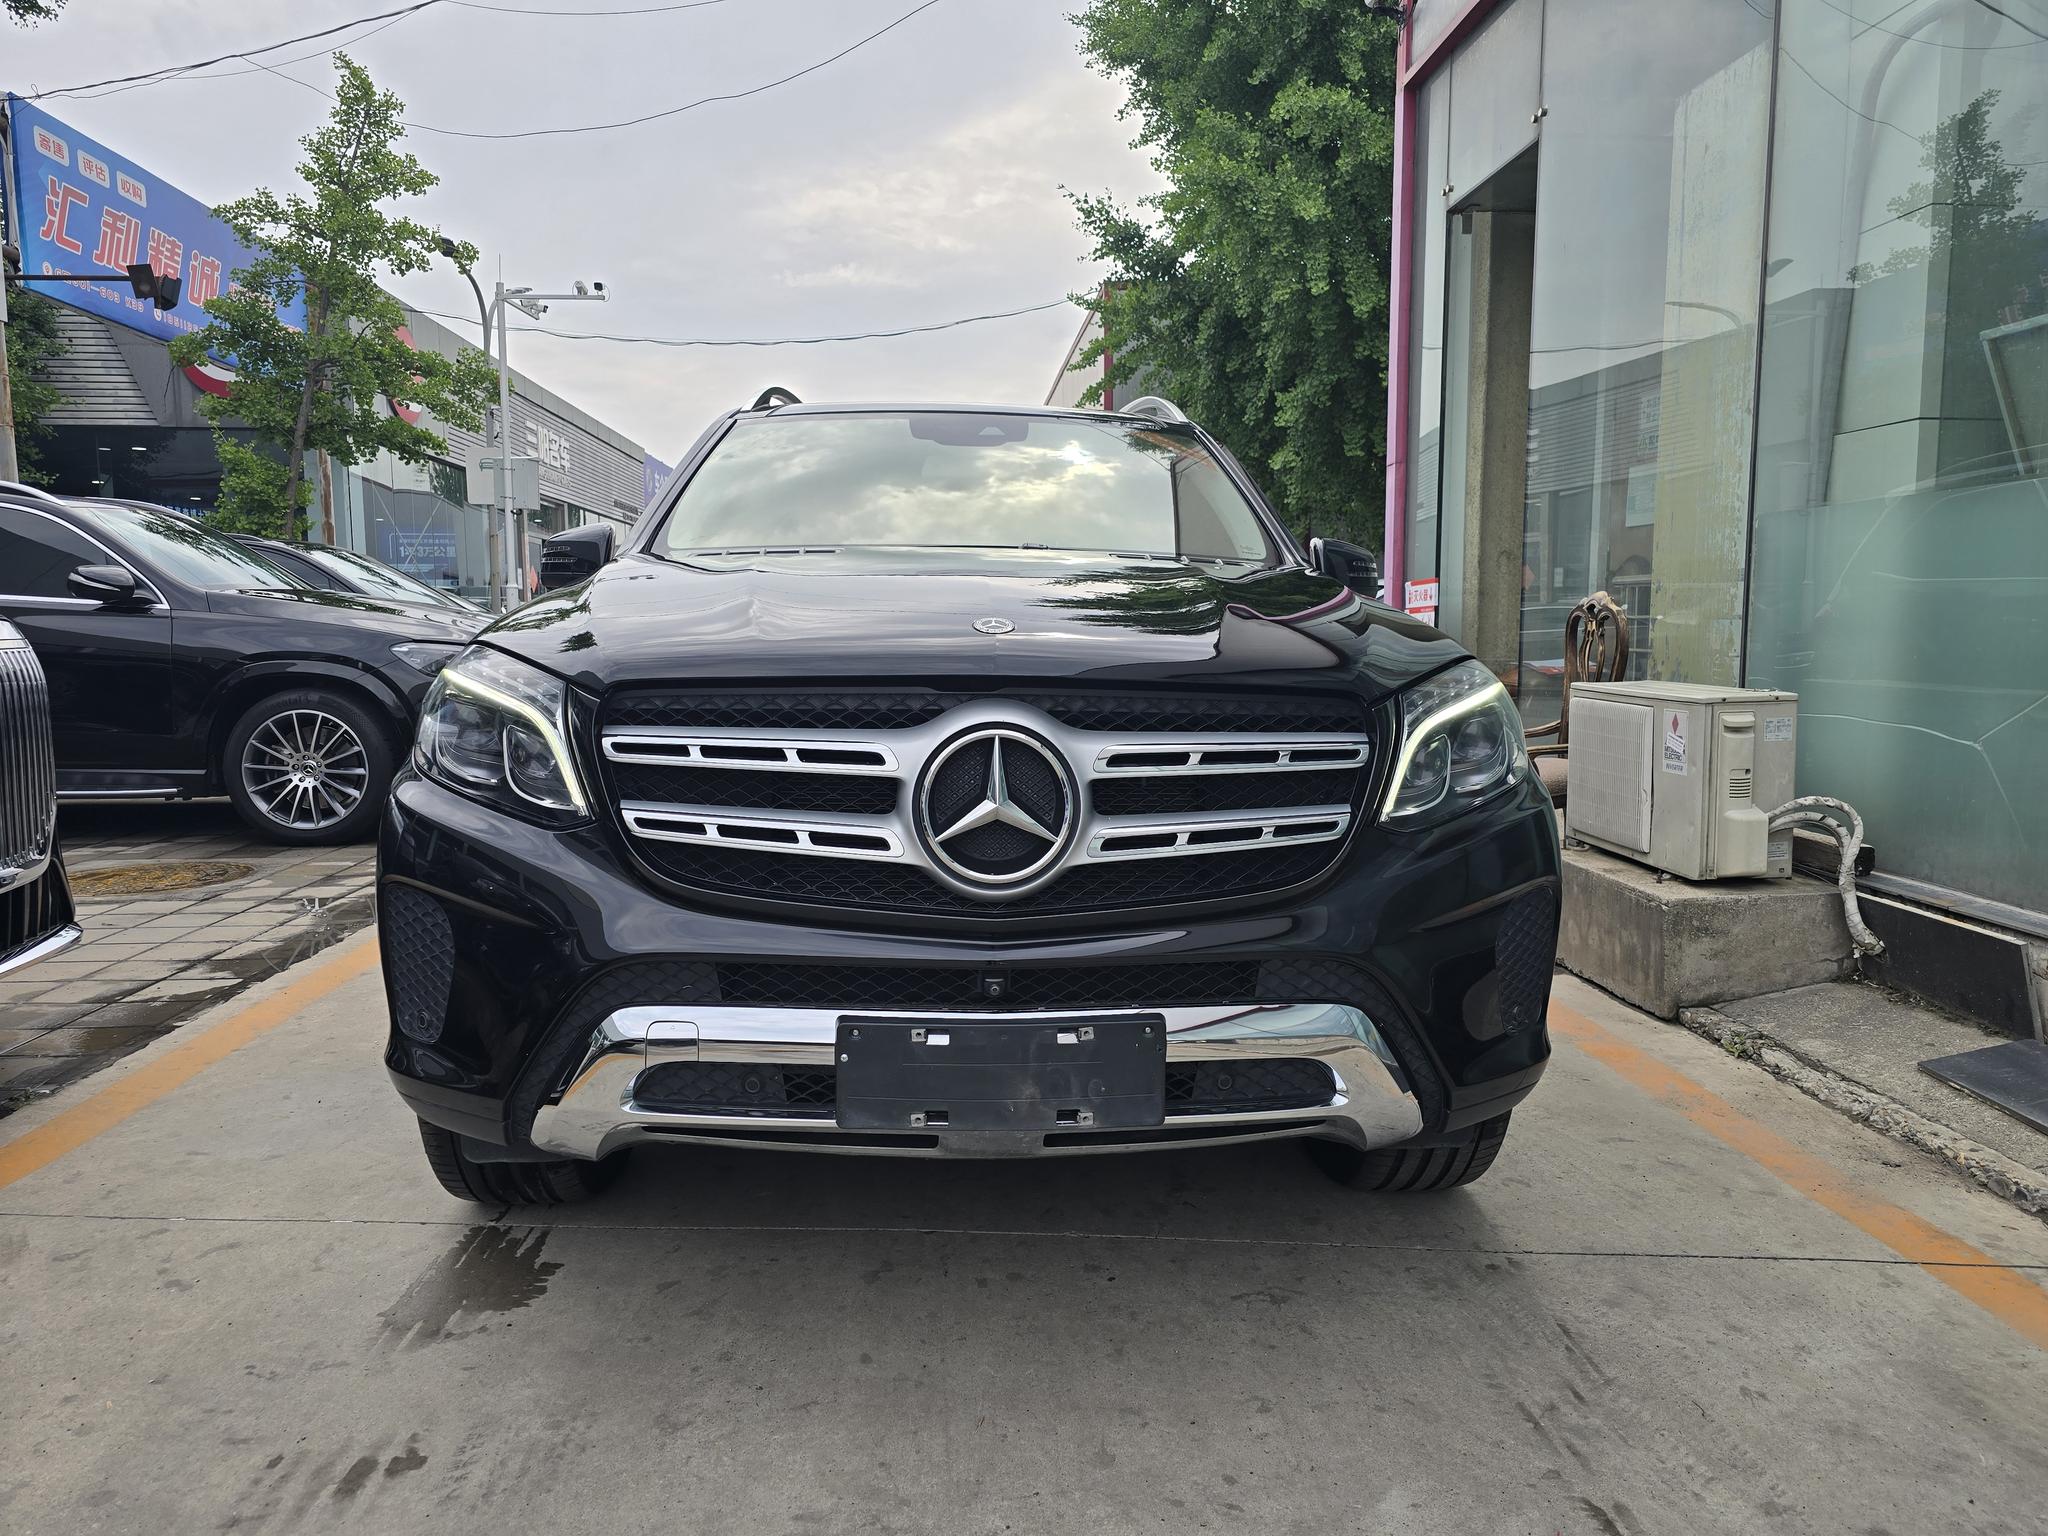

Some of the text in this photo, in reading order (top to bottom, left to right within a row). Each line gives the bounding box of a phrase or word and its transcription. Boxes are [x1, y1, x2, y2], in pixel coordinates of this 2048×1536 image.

[38, 132, 143, 202] 寄售 评估 收购
[40, 175, 222, 307] 汇利精诚
